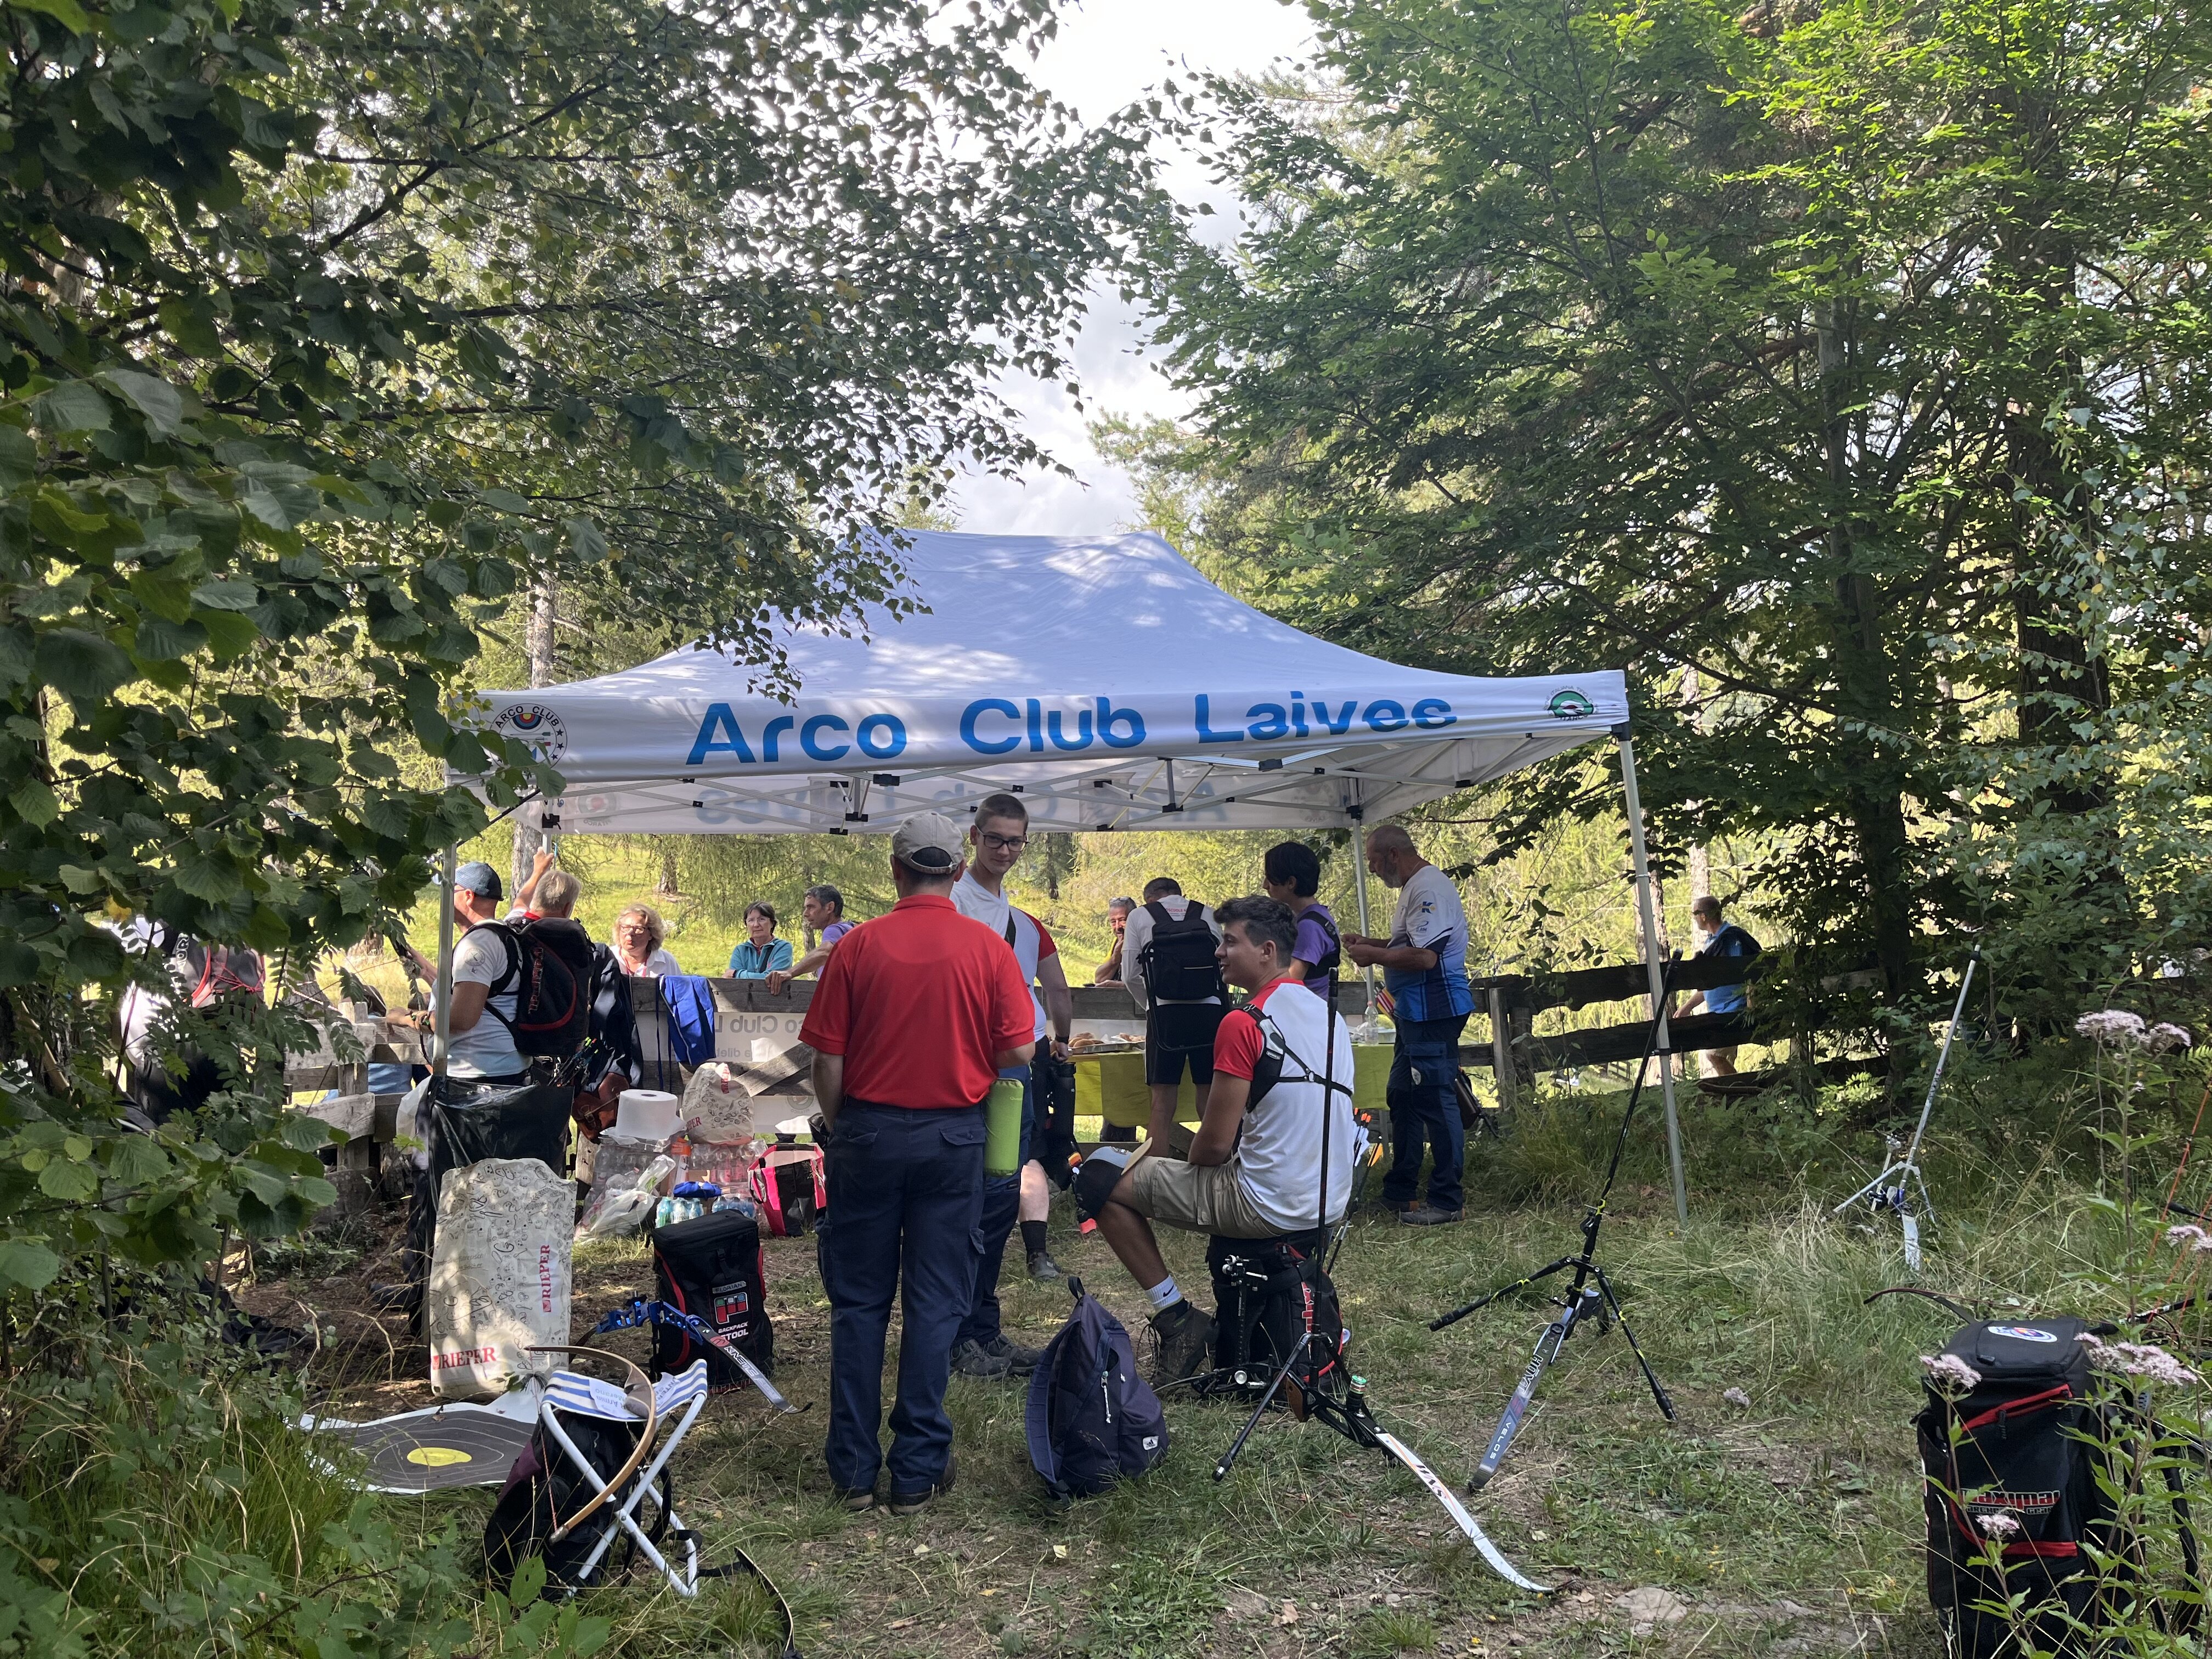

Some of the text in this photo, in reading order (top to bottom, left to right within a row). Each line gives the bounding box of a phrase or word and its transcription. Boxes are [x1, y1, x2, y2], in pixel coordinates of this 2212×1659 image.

[495, 706, 560, 729] ARCO CLUB
[685, 691, 1458, 765] Arco Club Laives
[539, 1244, 551, 1298] RIEPER
[718, 1321, 749, 1334] BACKPACK
[441, 1347, 496, 1369] RIEPER
[1517, 1353, 1544, 1395] HOYT
[1489, 1421, 1511, 1460] VELOS
